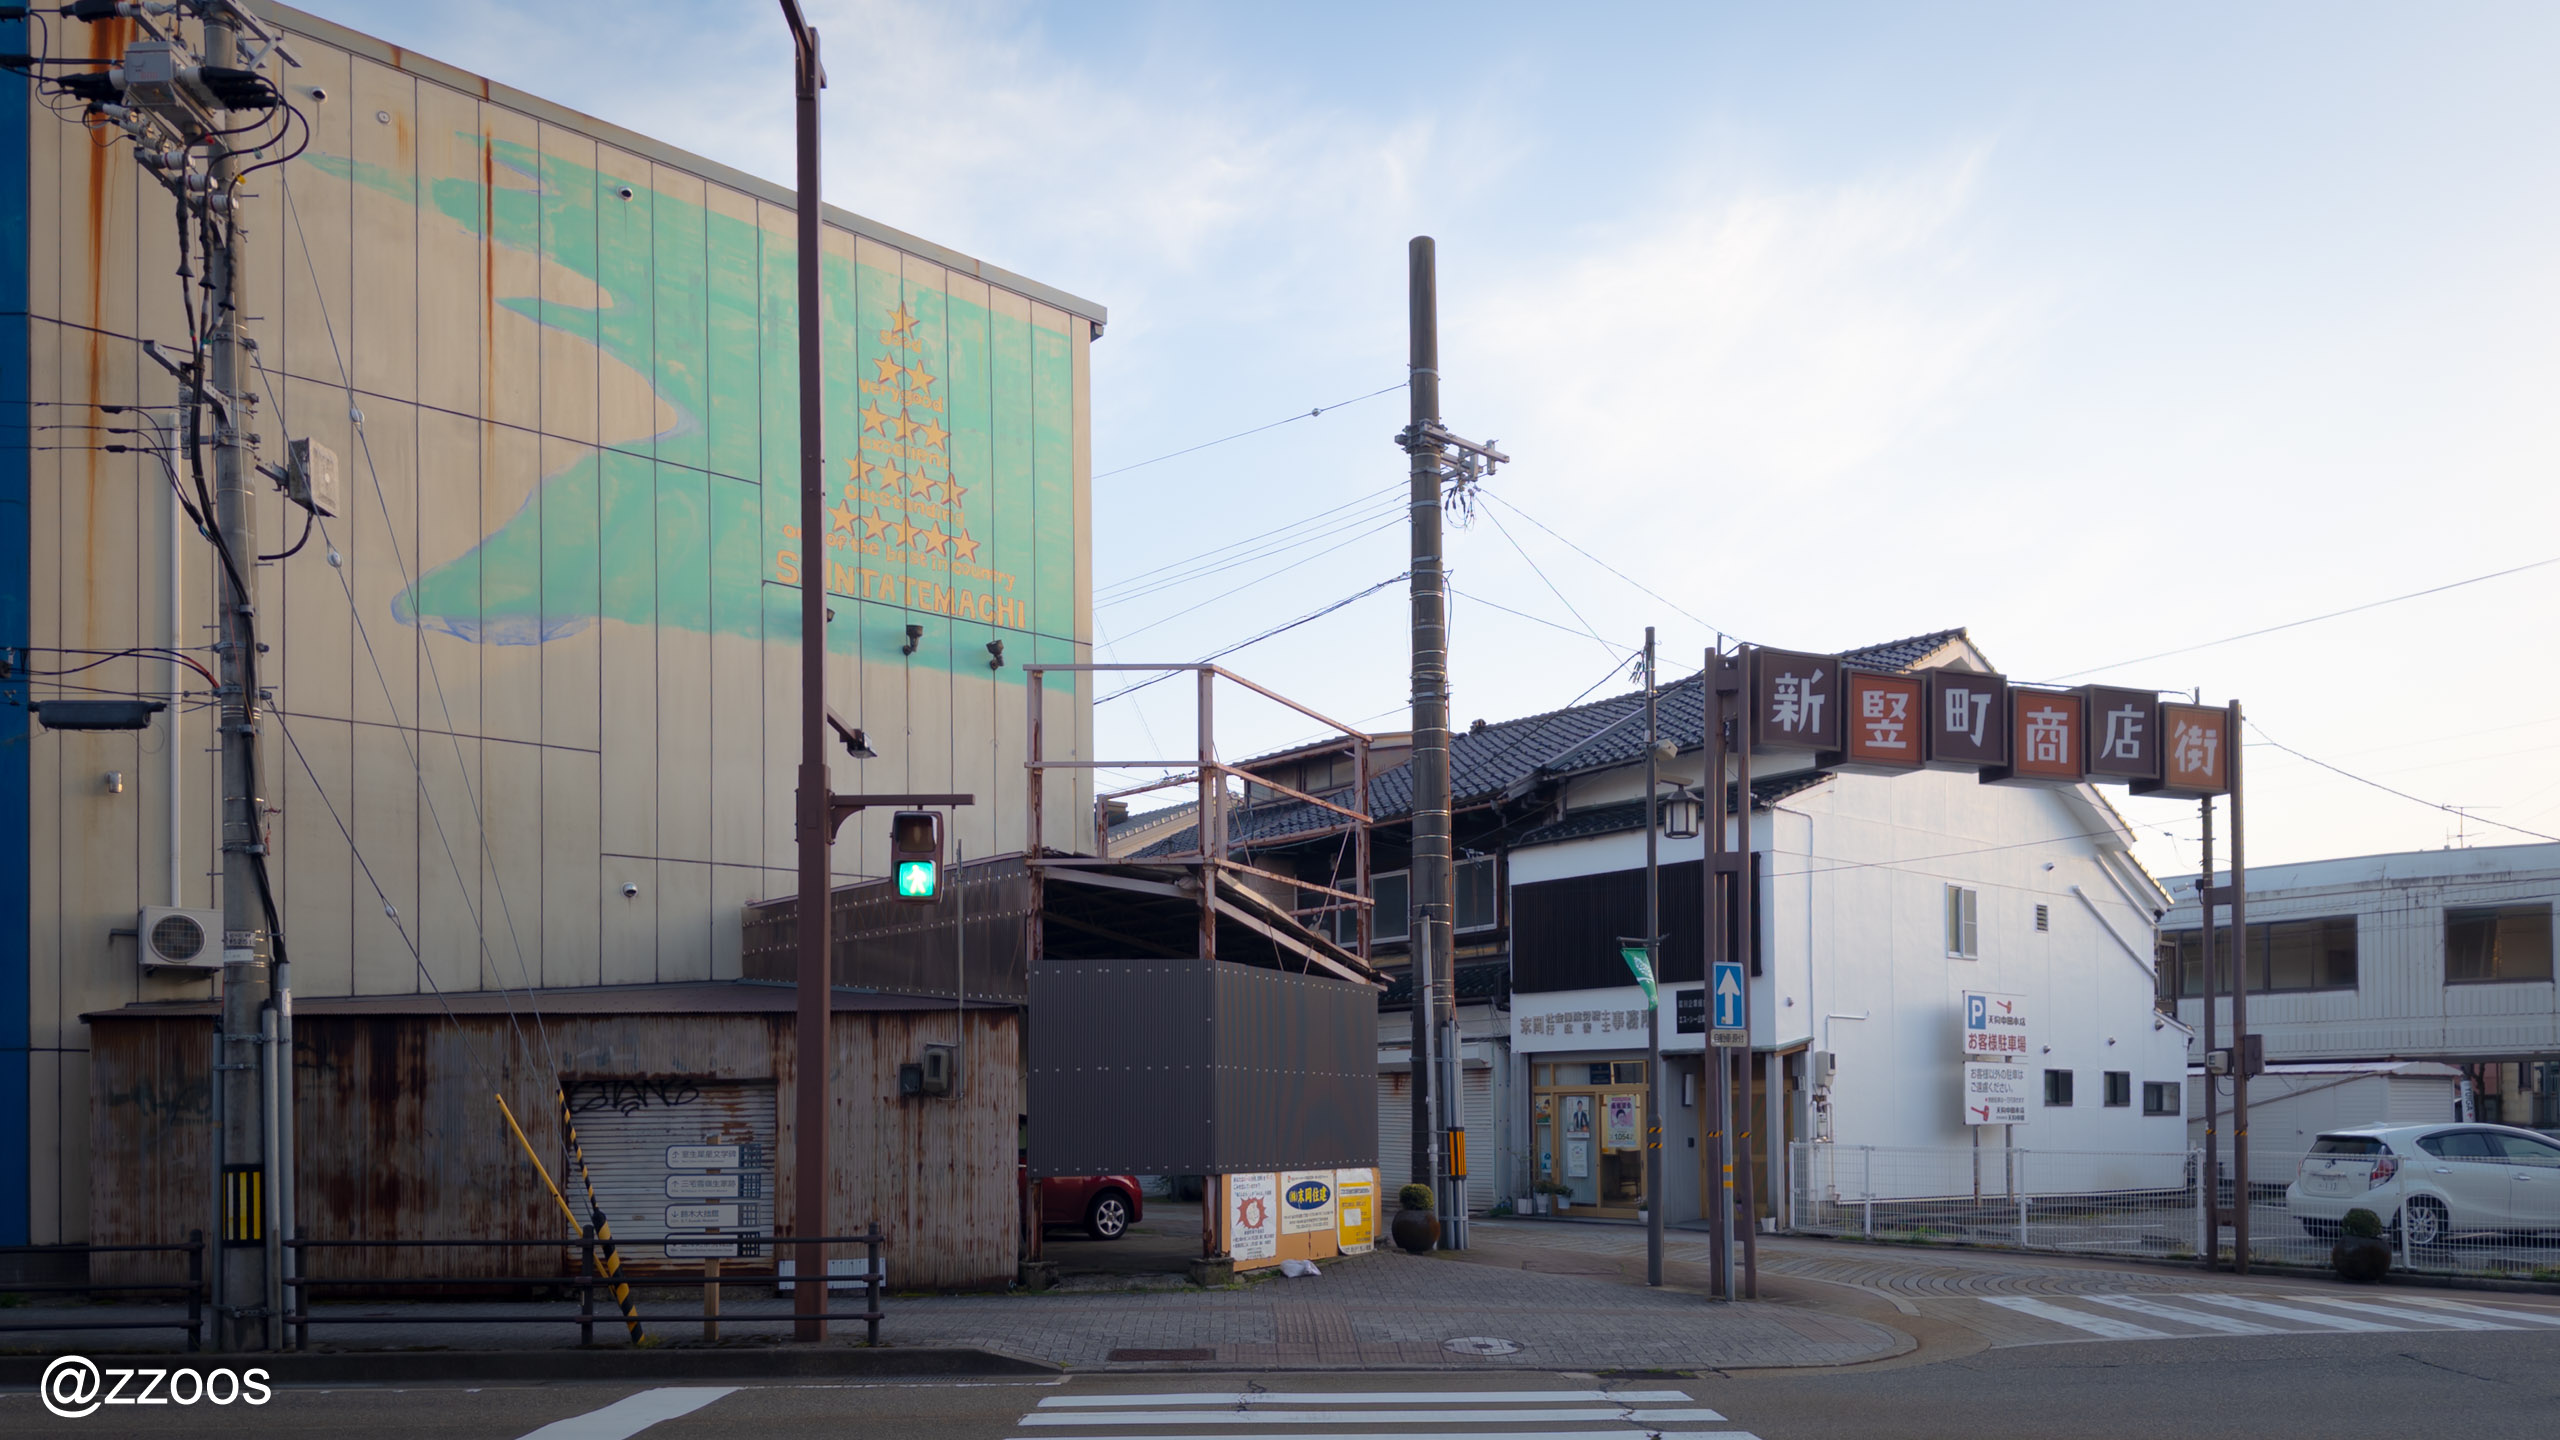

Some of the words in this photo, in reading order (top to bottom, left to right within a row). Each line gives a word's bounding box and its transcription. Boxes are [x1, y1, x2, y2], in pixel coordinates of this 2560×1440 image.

[880, 330, 922, 353] good
[859, 378, 899, 403] very
[903, 387, 944, 413] good
[826, 532, 847, 551] of
[850, 536, 880, 557] the
[886, 543, 927, 567] best
[931, 554, 948, 572] in
[951, 561, 1016, 592] country
[775, 549, 1026, 628] SINTATEMACHI
[1971, 999, 1984, 1026] P
[1968, 1033, 2027, 1053] お客様駐車場
[1970, 1067, 2024, 1081] お客様以外の駐車は
